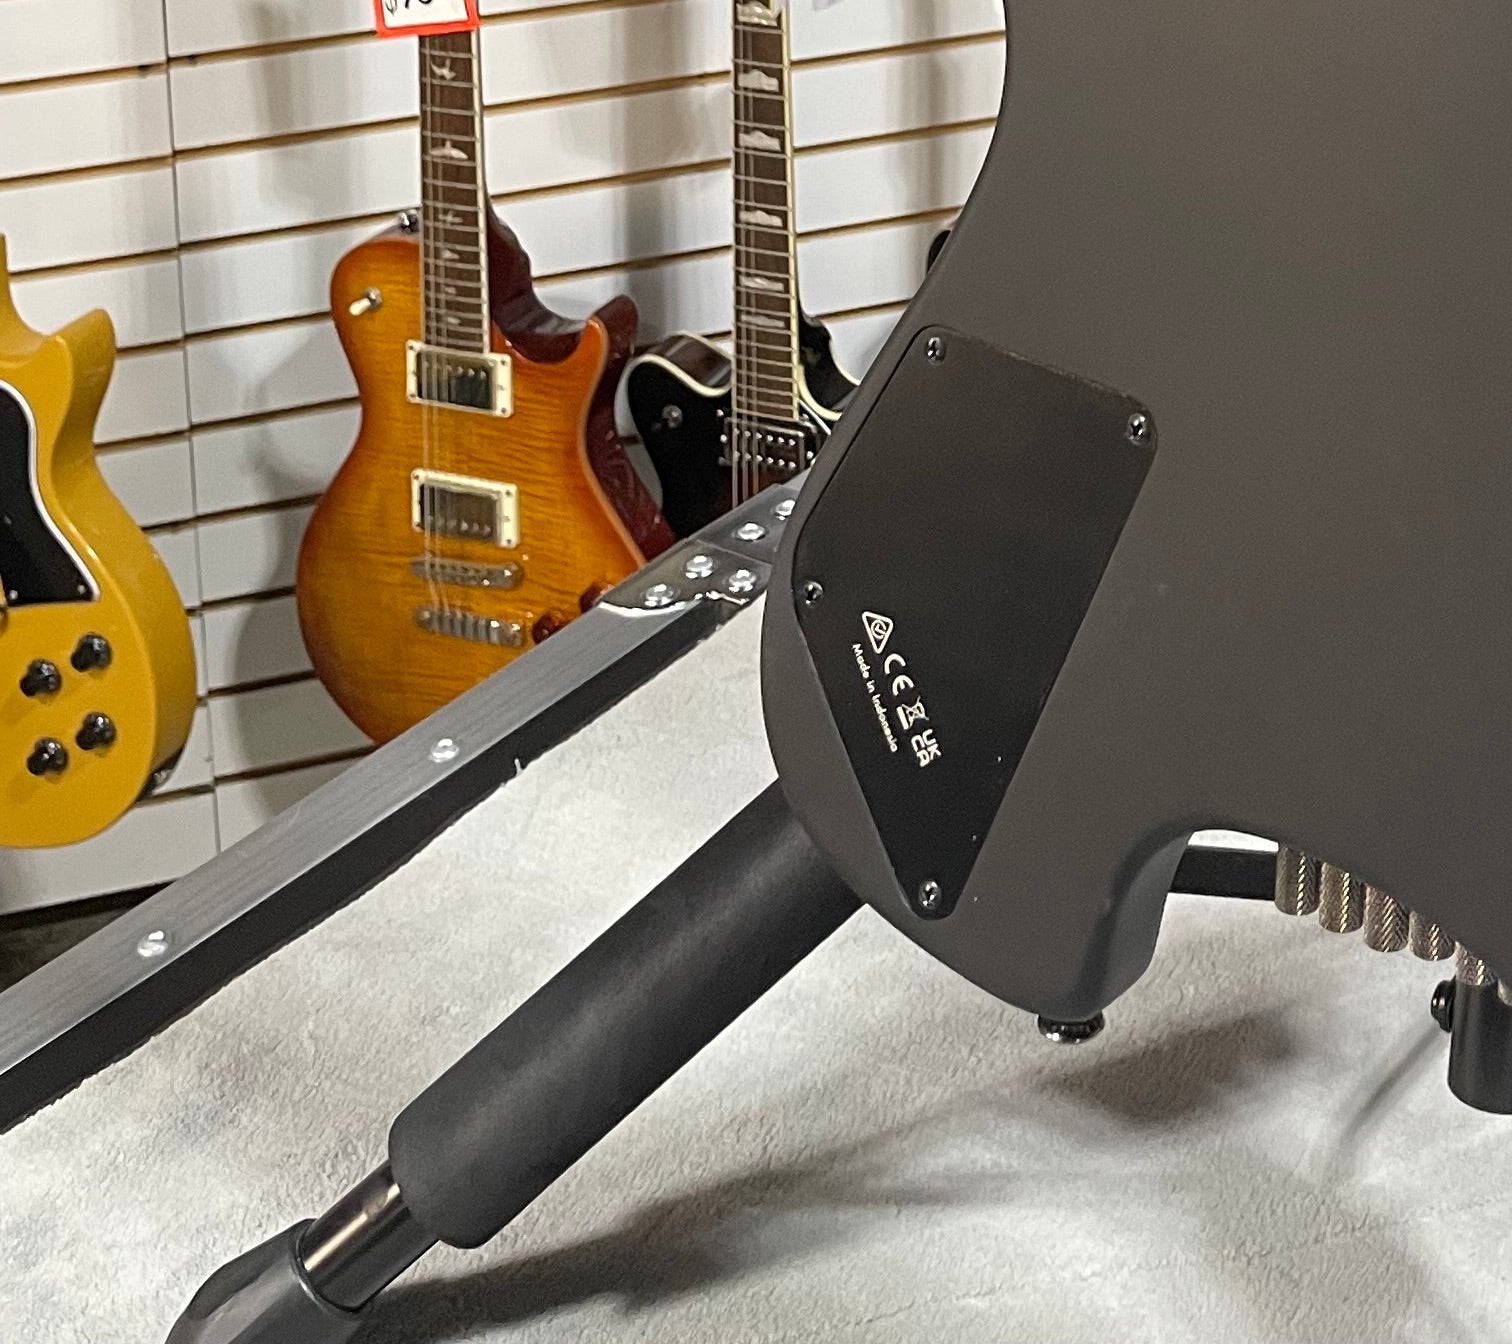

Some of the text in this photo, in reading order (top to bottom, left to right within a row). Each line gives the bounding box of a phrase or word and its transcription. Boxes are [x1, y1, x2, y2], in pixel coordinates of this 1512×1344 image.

[852, 643, 898, 752] Made in Indonesia
